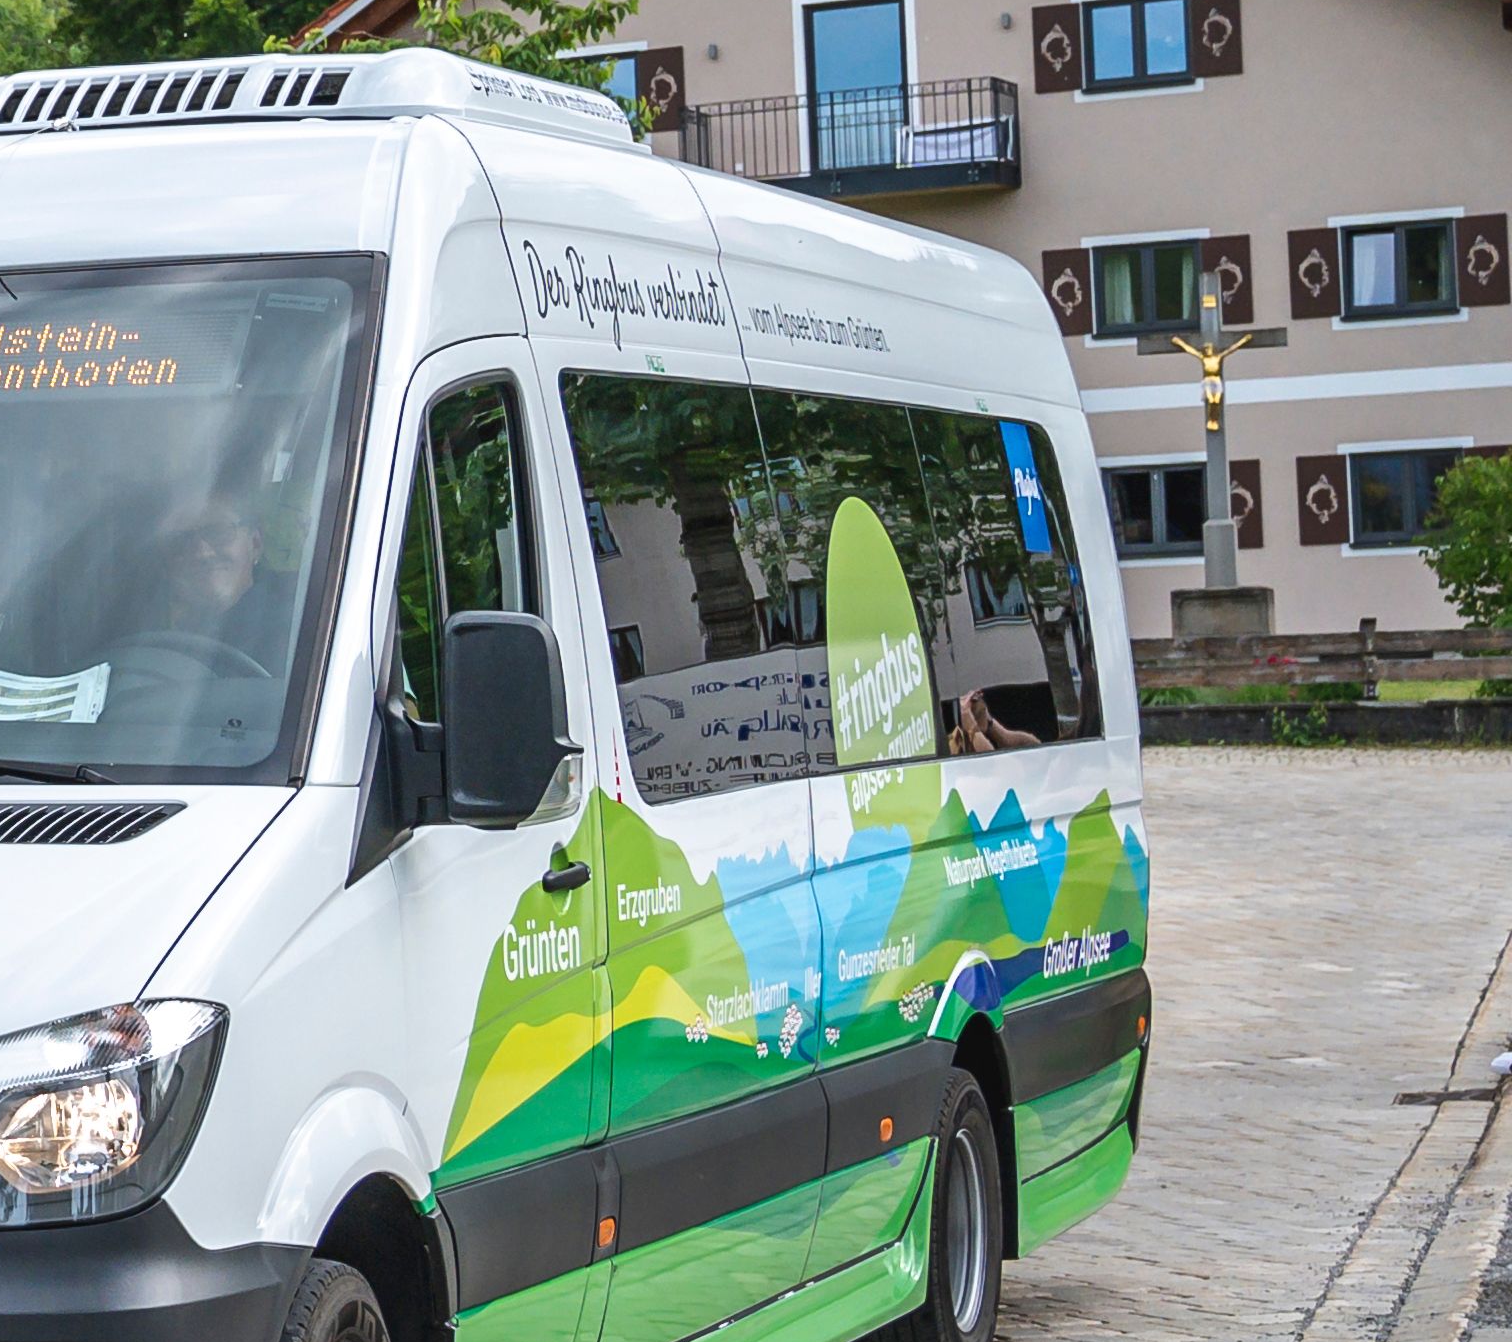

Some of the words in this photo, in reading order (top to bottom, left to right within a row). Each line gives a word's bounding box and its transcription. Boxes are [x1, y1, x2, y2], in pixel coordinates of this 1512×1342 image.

[522, 239, 570, 319] Der
[565, 245, 646, 352] Ringbus
[646, 263, 726, 327] verbindet
[748, 306, 777, 335] vom
[773, 303, 812, 346] Alpsee
[837, 632, 922, 752] #ringbus
[617, 877, 681, 927] Erzgruben
[503, 919, 581, 981] Grünten
[838, 938, 901, 982] Gunzesrieder
[901, 933, 916, 967] Tal
[1043, 930, 1078, 979] Großer
[1077, 924, 1112, 977] Alpsee
[706, 978, 789, 1029] Starzlachklamm
